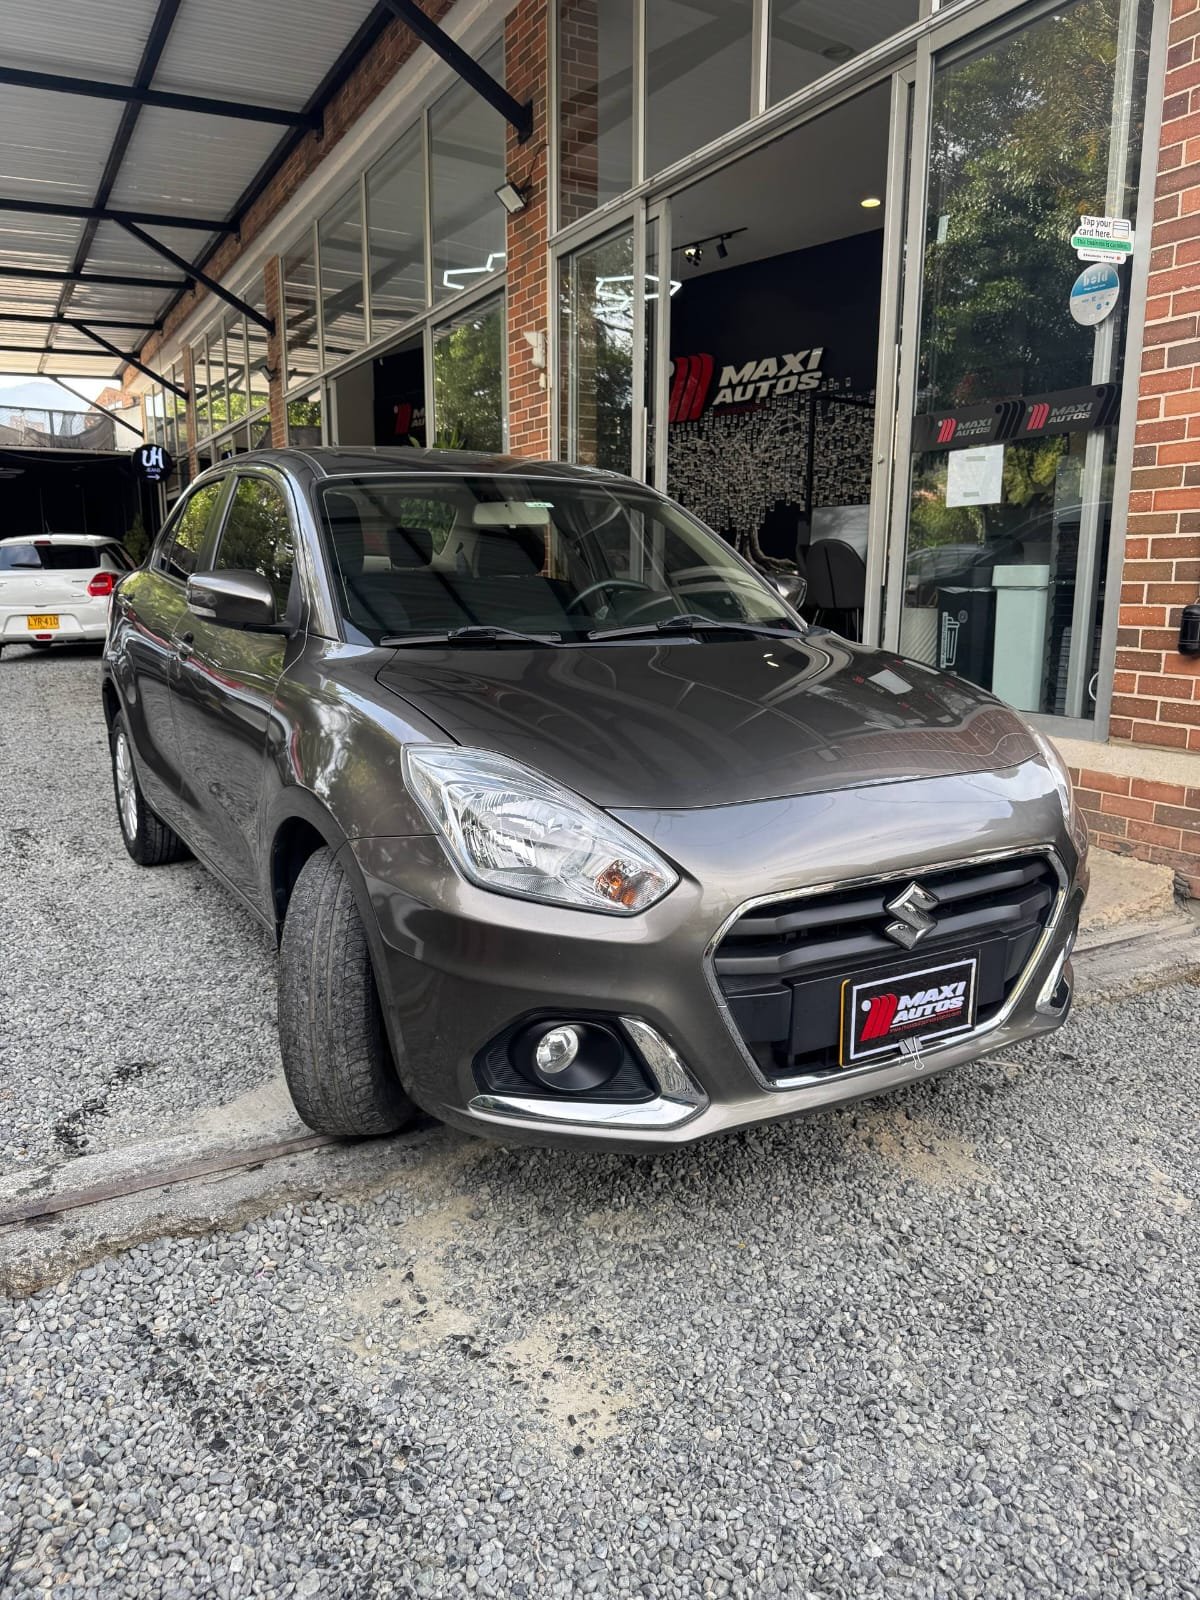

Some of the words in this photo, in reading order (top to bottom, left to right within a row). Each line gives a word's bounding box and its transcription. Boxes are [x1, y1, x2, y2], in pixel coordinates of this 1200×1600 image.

[1083, 217, 1095, 227] Tap
[1096, 220, 1112, 228] your
[1079, 228, 1094, 236] card
[1095, 229, 1112, 239] here.
[1083, 269, 1109, 287] bold
[719, 347, 823, 387] MAXI
[712, 371, 822, 405] AUTOS
[1051, 402, 1093, 416] MAXI
[957, 418, 993, 430] MAXI
[1048, 411, 1091, 424] AUTOS
[955, 426, 991, 437] AUTOS
[142, 446, 164, 469] UH
[897, 981, 967, 1010] MAXI
[892, 996, 965, 1024] AUTOS
